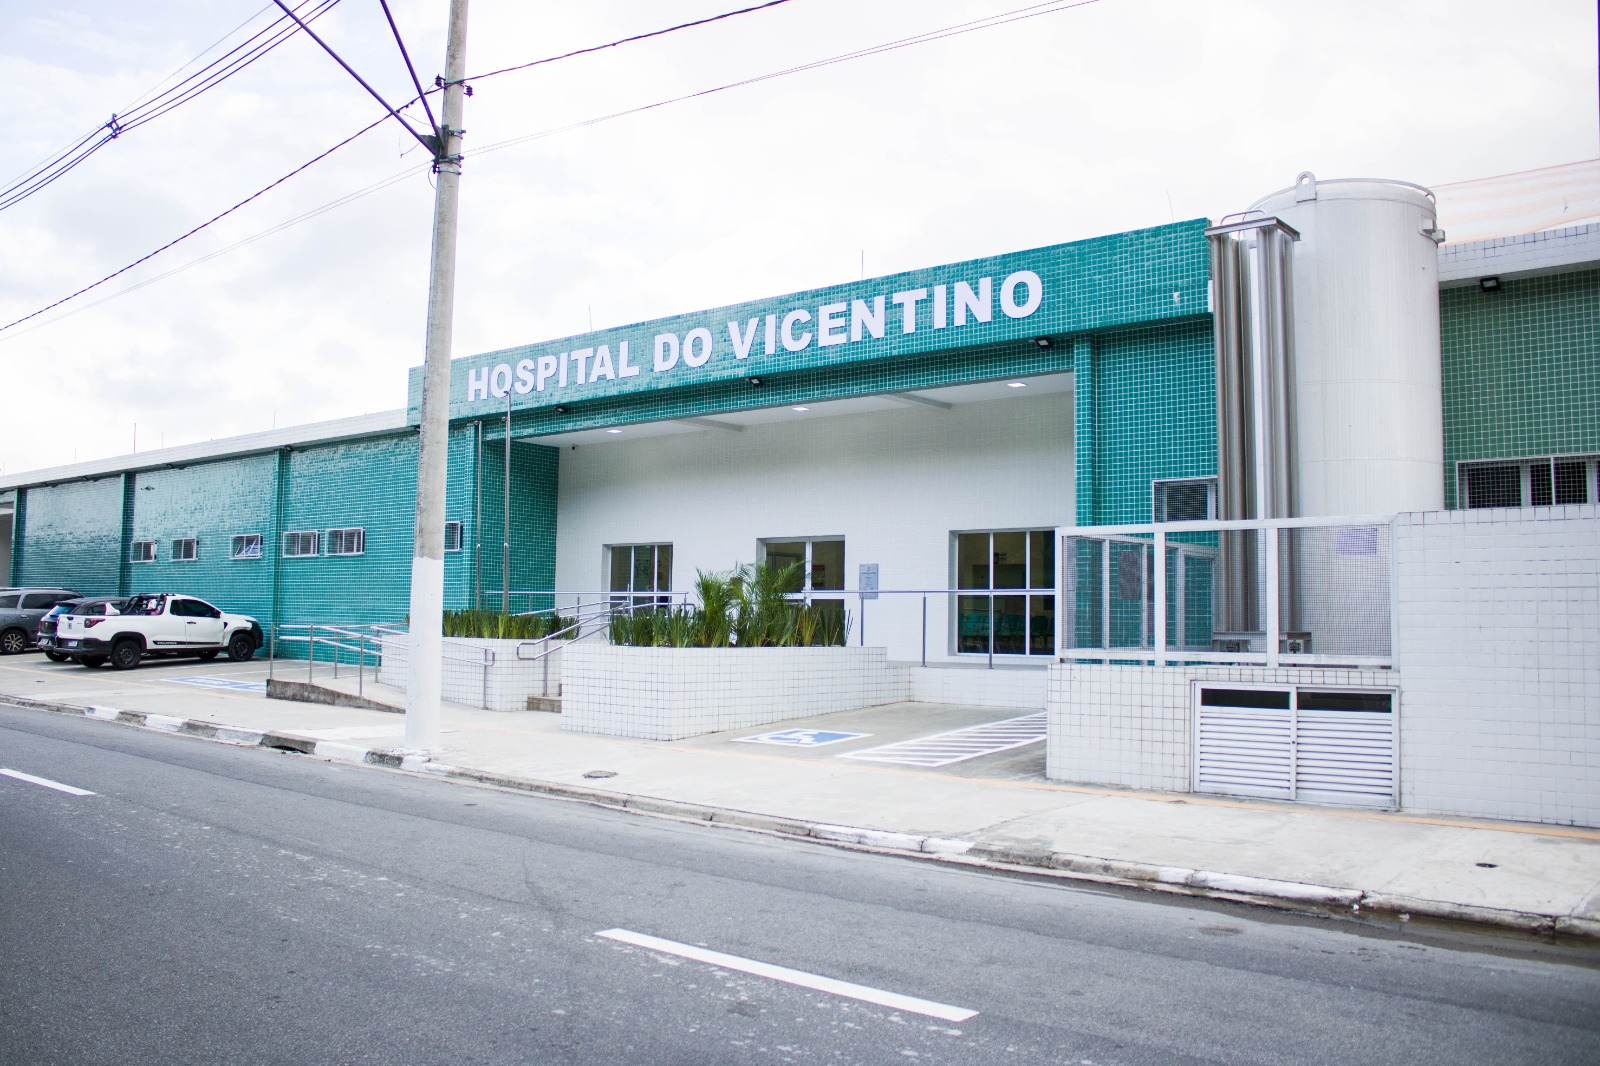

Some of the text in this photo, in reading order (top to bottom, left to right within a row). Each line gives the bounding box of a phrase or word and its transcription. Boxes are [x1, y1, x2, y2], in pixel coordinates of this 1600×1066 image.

[467, 270, 1043, 402] HOSPITAL DO VICENTINO
